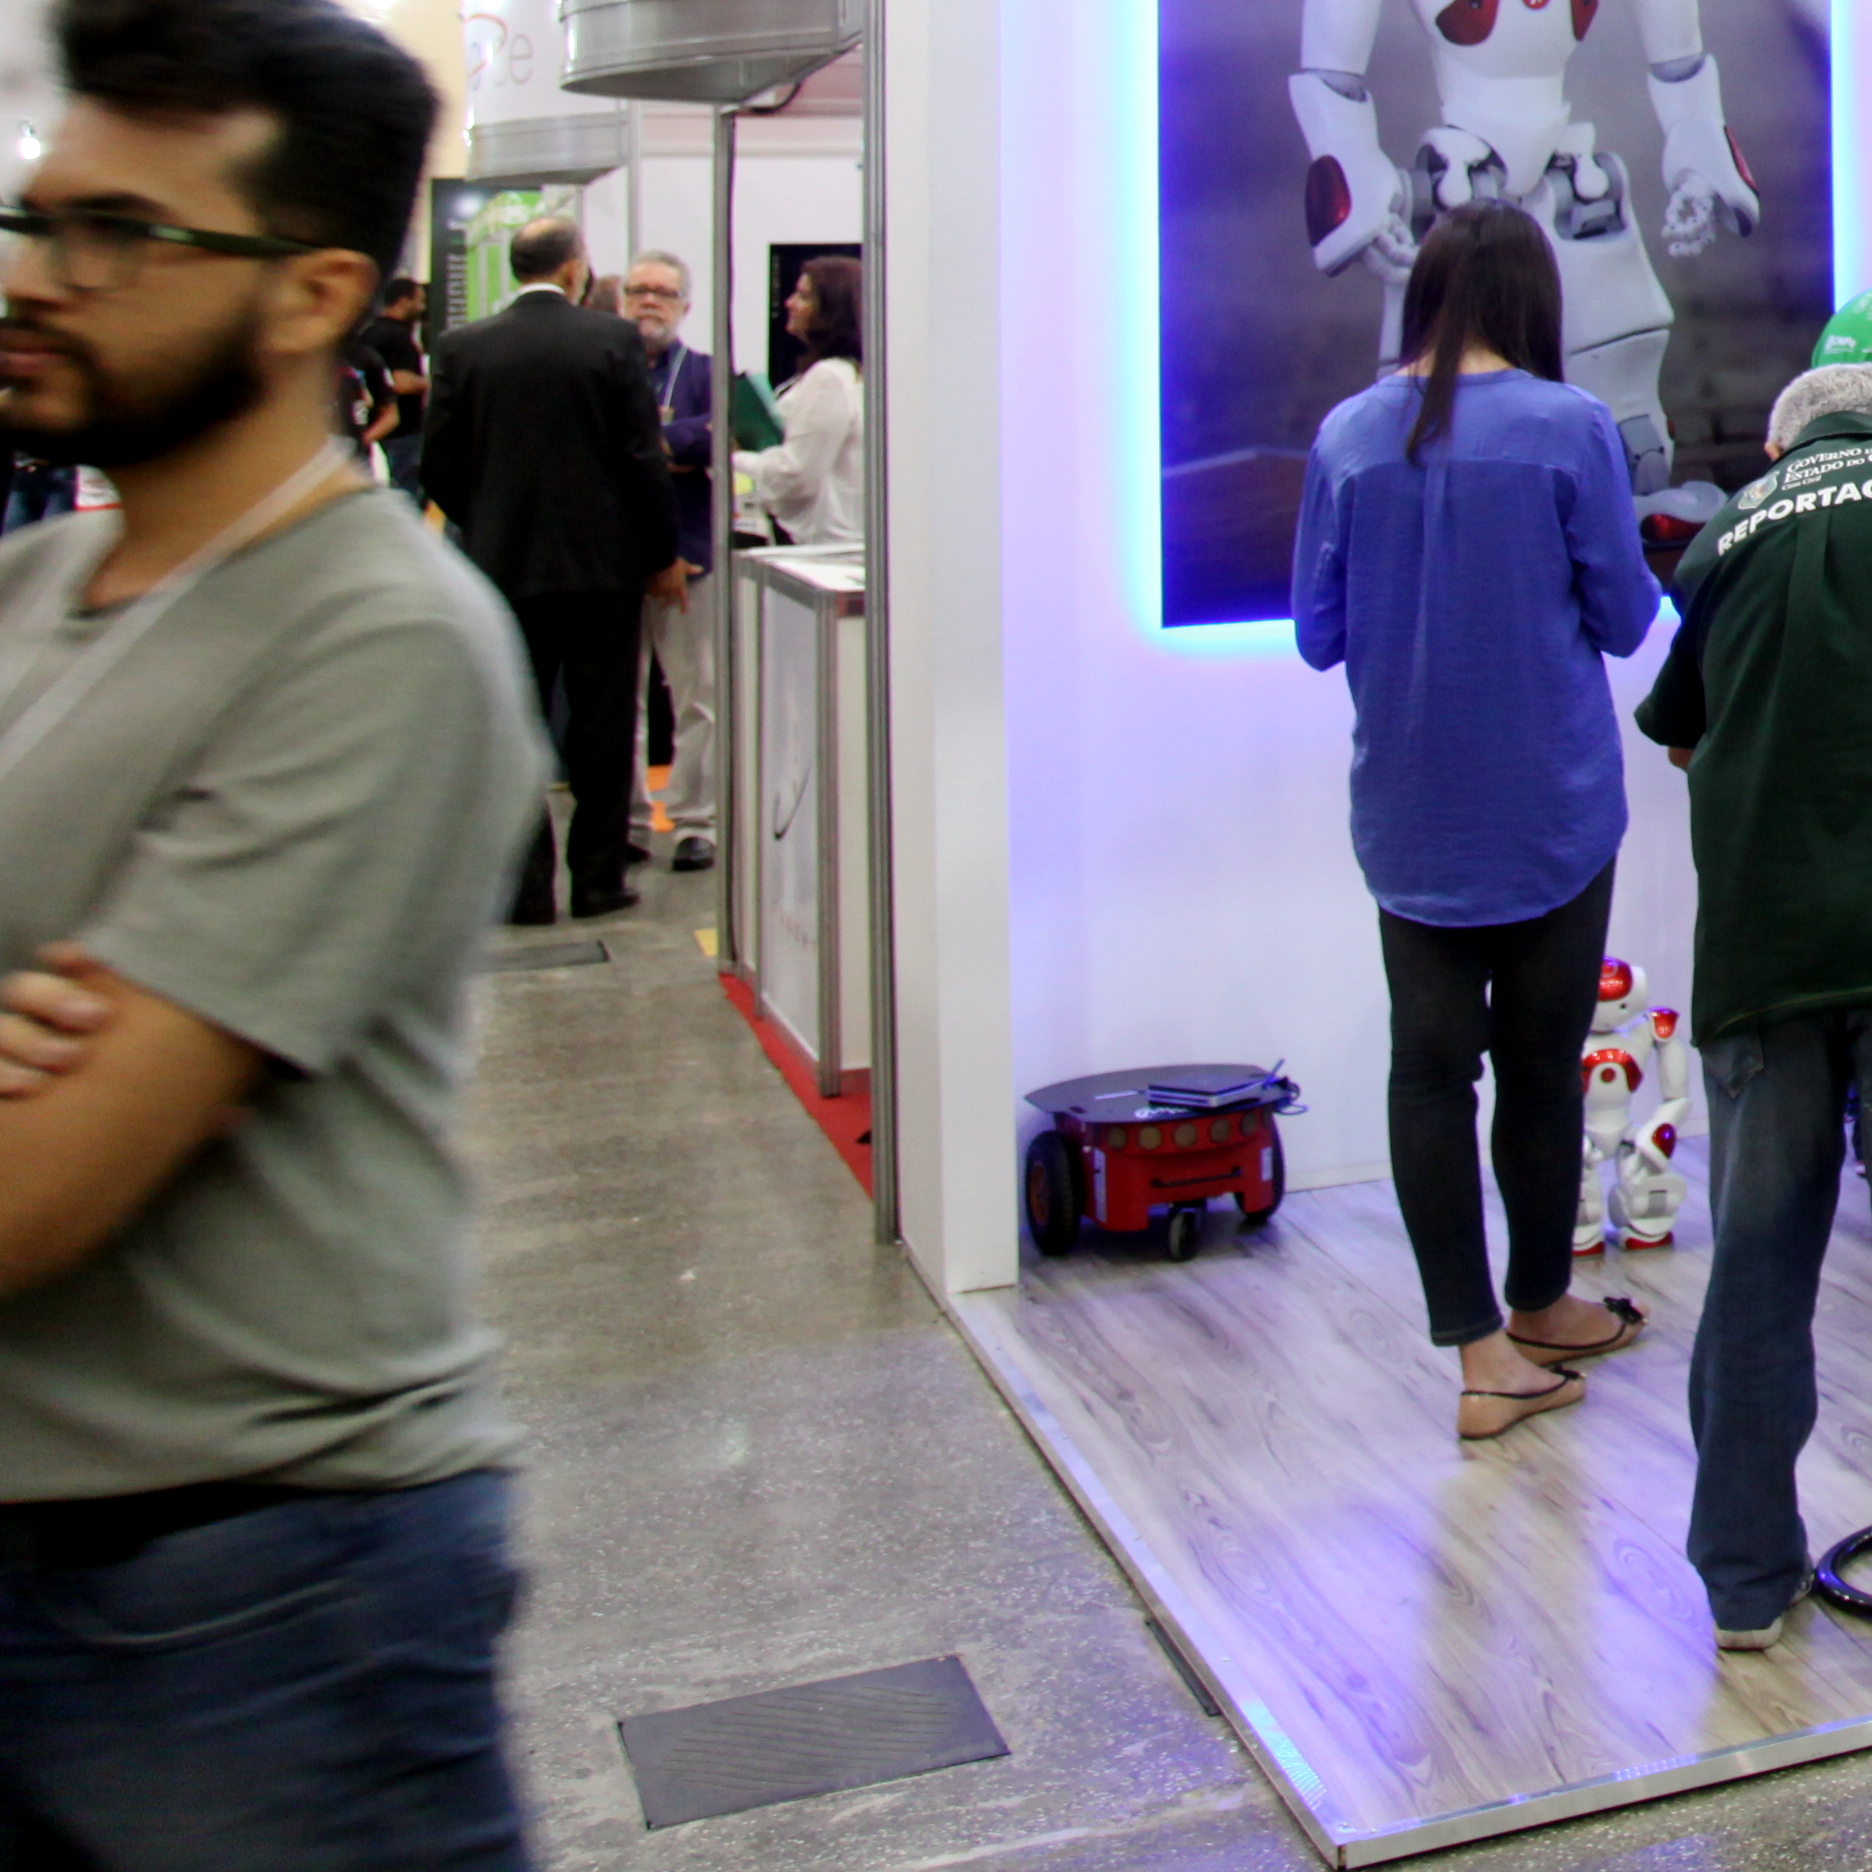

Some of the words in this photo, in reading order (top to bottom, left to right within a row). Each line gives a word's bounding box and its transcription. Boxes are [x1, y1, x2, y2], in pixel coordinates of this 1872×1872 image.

[1782, 460, 1844, 485] ESTADO
[1846, 457, 1866, 468] DO
[1786, 447, 1862, 473] GOVERNO
